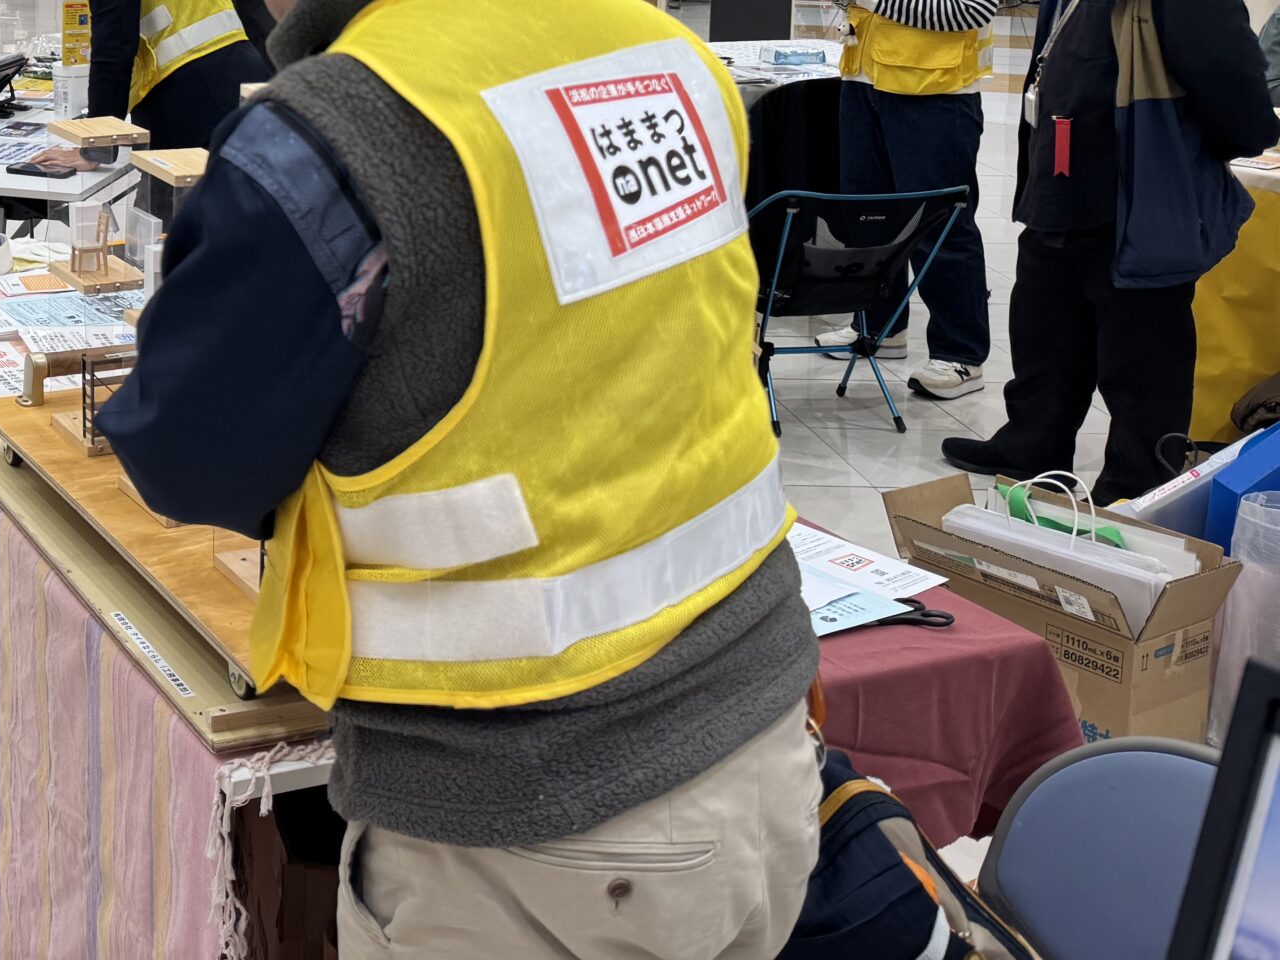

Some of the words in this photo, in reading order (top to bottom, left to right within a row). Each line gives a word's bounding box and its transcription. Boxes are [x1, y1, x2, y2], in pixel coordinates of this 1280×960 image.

[590, 107, 686, 159] はままつ
[1063, 649, 1121, 680] 80829422
